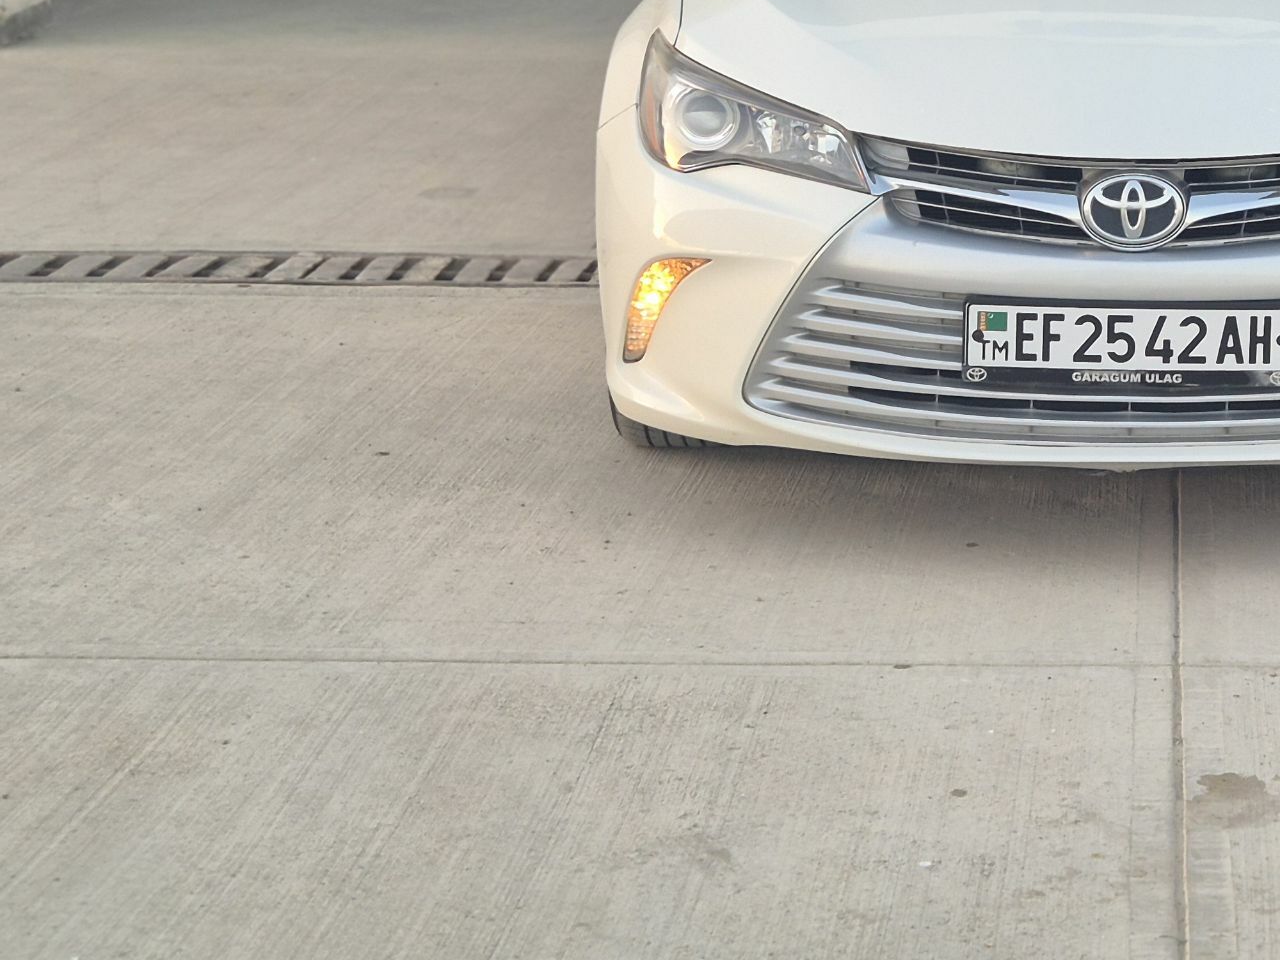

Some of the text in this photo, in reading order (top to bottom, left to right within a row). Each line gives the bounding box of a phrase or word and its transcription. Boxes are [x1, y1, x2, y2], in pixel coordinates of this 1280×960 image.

[979, 339, 1009, 362] TM
[1071, 370, 1183, 384] GARAGUM ULAG
